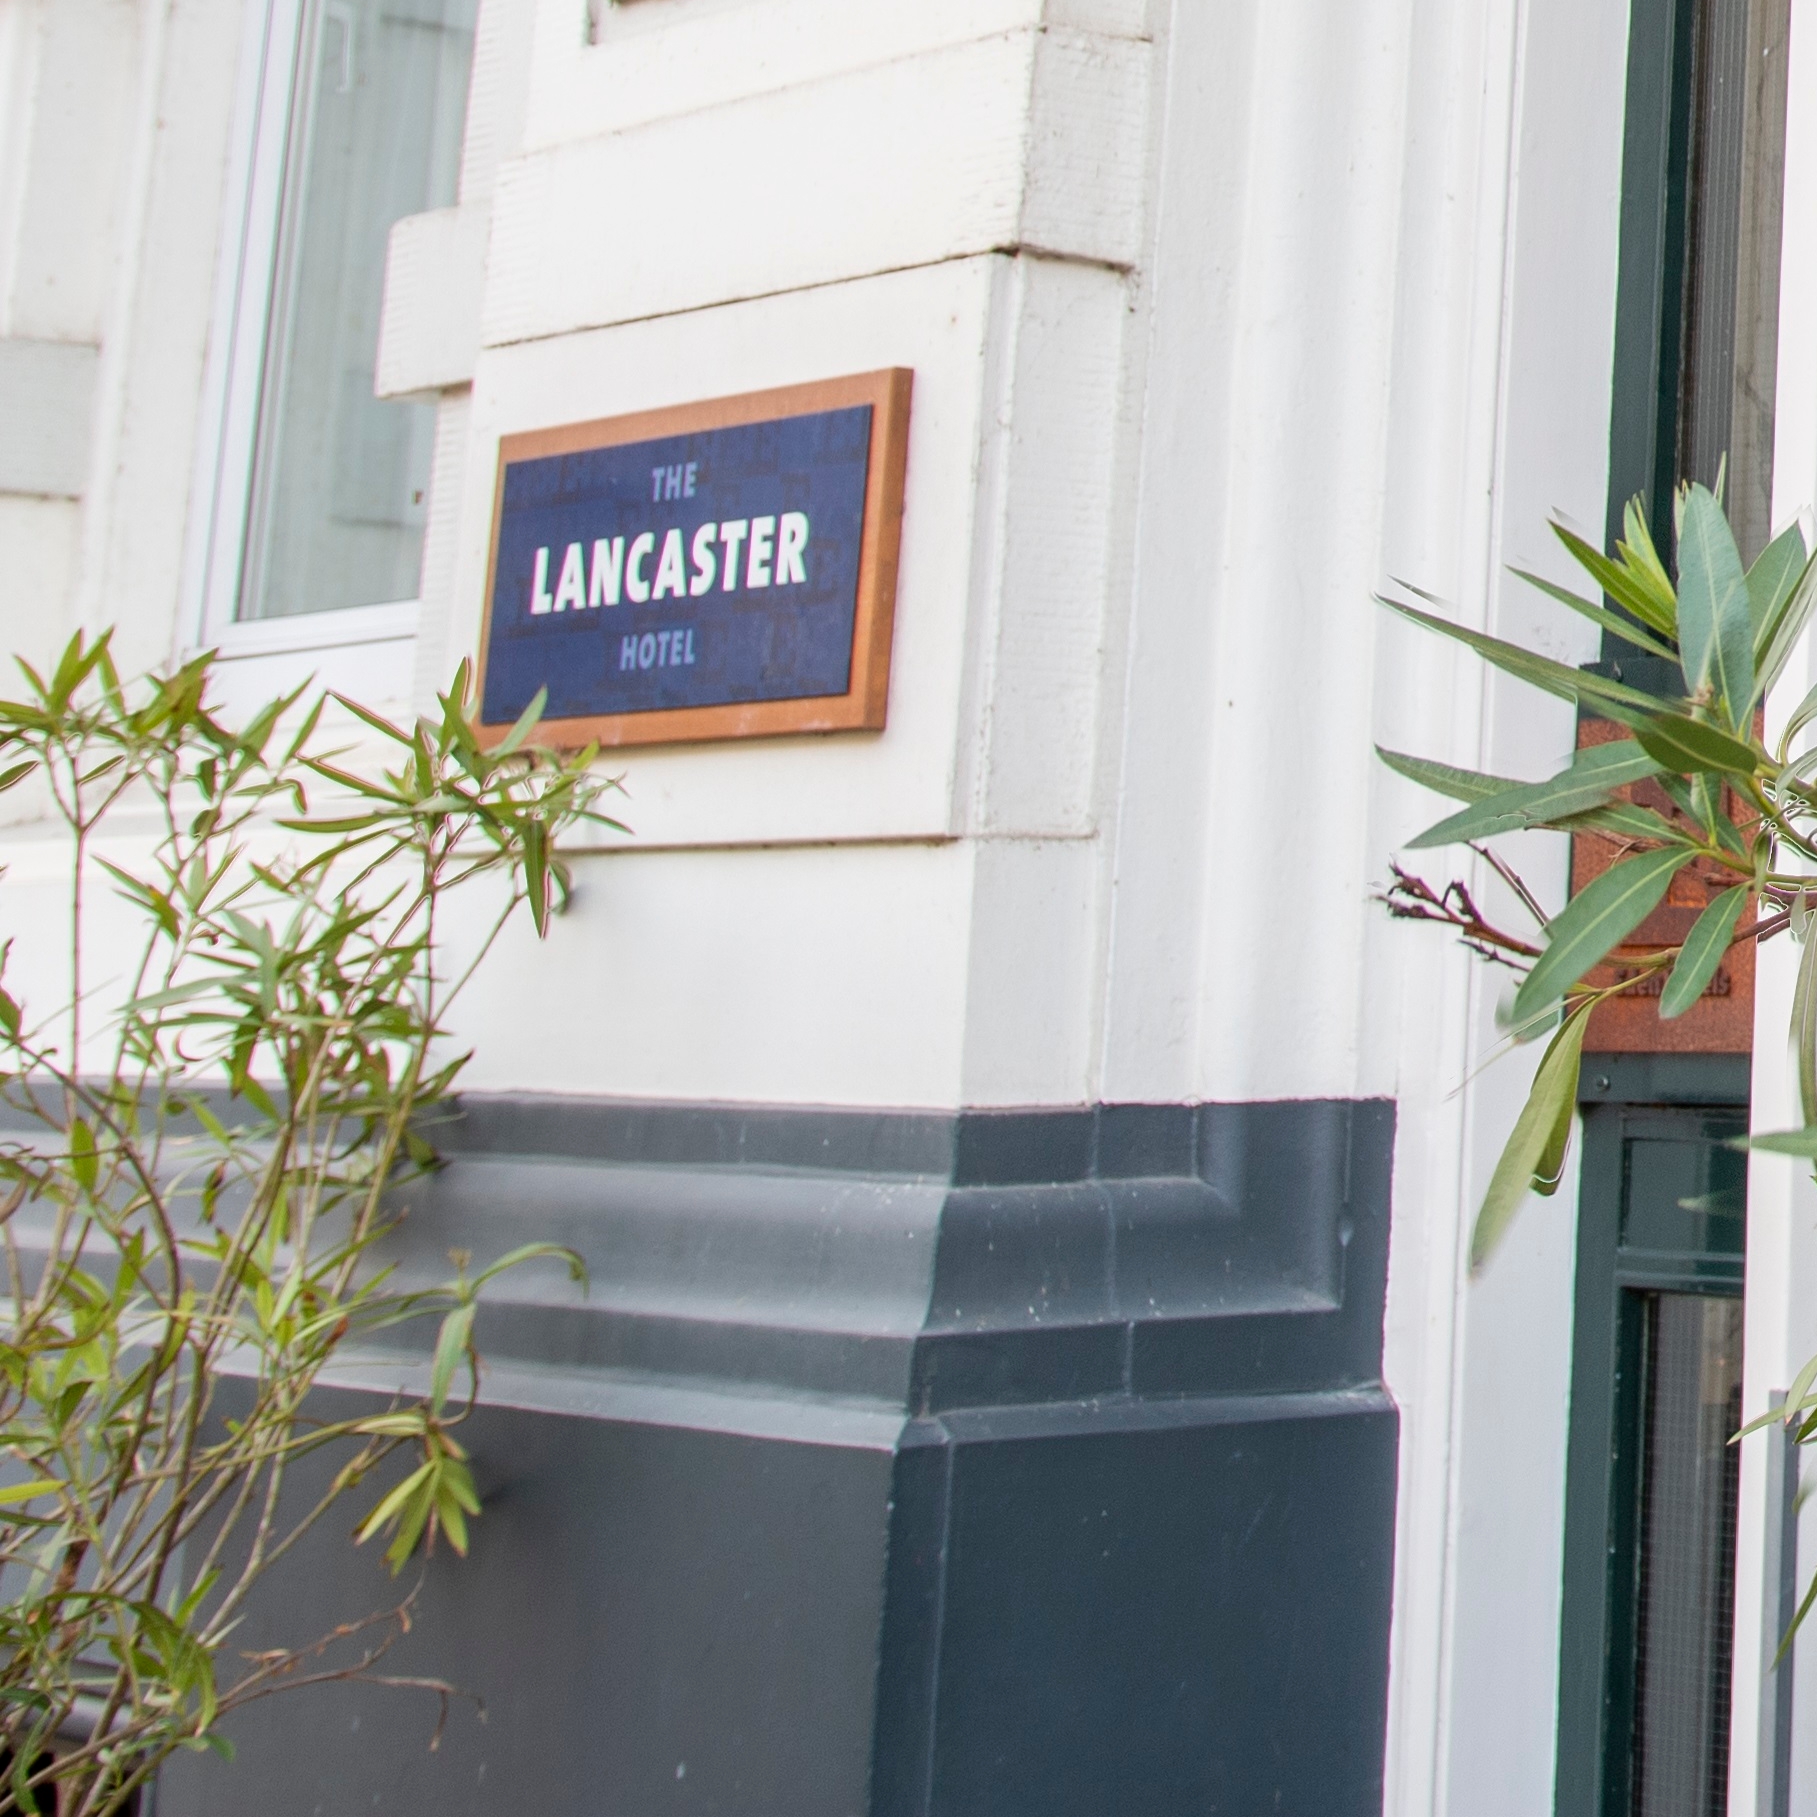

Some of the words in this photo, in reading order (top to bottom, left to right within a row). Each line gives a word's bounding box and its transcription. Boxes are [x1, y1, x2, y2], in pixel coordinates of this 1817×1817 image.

[651, 461, 698, 503] THE
[530, 511, 810, 616] LANCASTER
[619, 629, 696, 671] HOTEL
